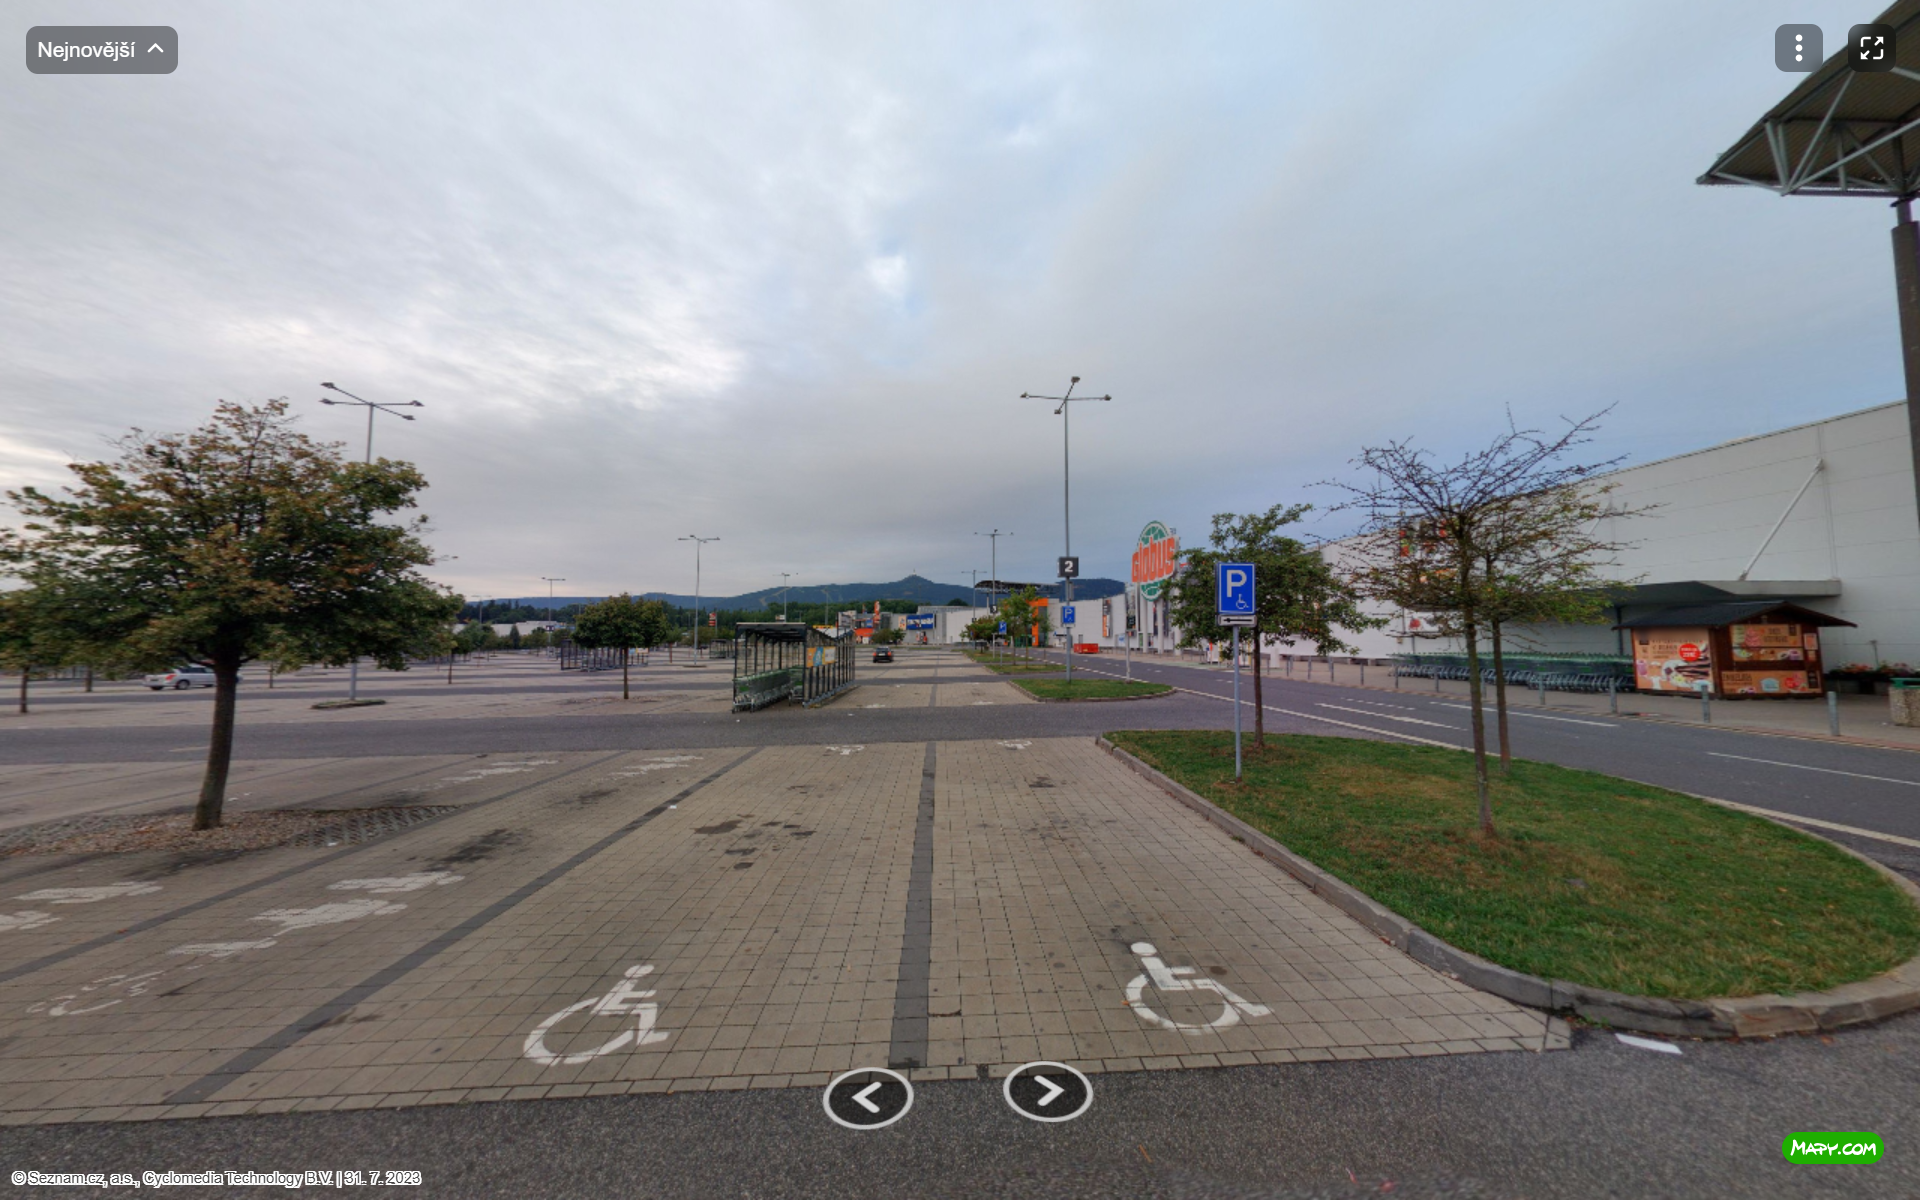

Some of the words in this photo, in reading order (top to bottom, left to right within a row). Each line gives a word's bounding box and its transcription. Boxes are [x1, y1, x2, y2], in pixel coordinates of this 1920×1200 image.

[1064, 560, 1074, 573] 2
[1131, 536, 1175, 582] Globus
[1226, 569, 1247, 598] P
